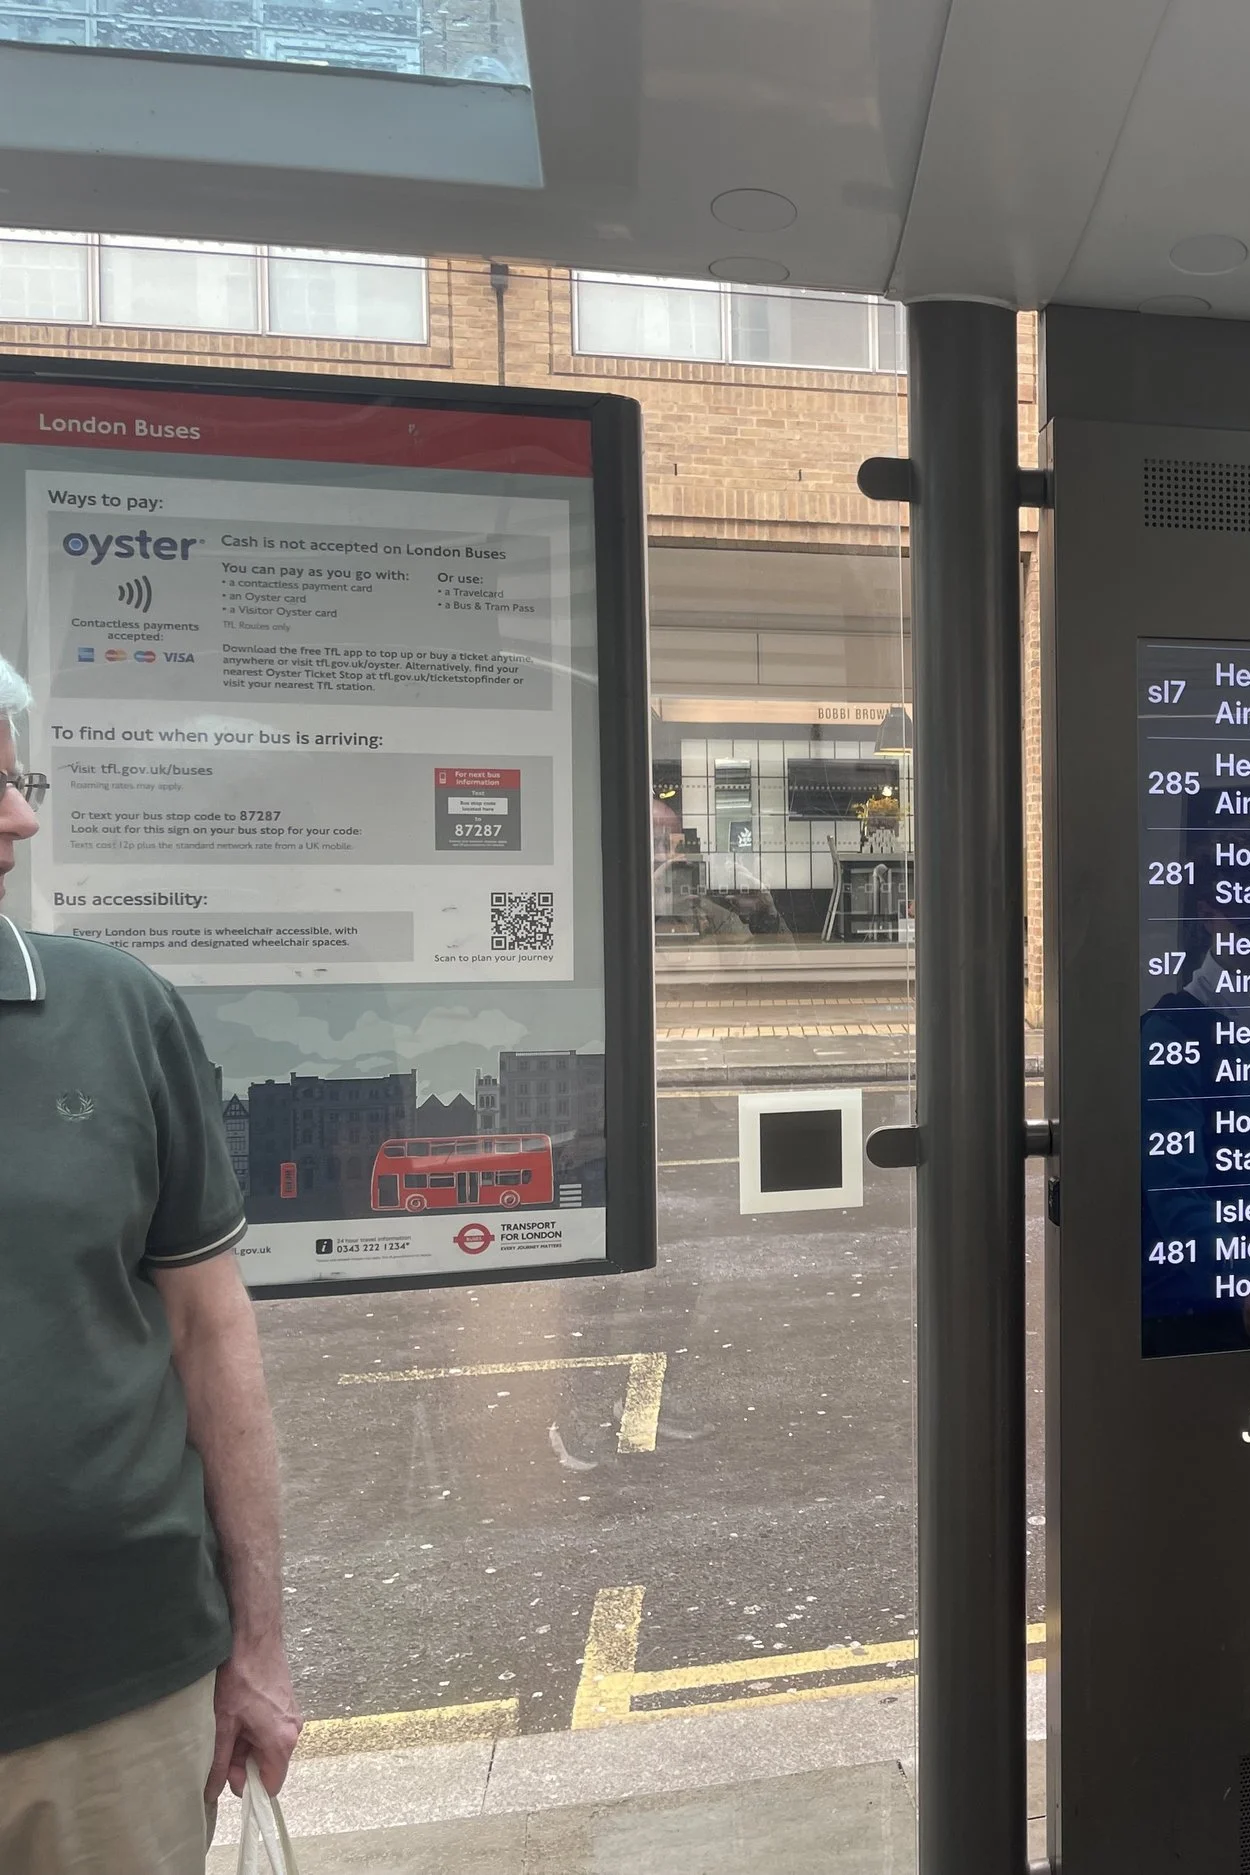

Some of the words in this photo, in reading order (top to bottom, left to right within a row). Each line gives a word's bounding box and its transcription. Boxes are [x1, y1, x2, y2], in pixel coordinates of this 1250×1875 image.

[39, 413, 126, 435] London
[134, 419, 200, 439] Buses
[47, 489, 96, 508] Ways
[101, 493, 121, 507] to
[126, 497, 164, 512] pay:
[62, 529, 197, 565] oyster
[220, 534, 258, 547] Cash
[263, 536, 275, 548] is
[279, 539, 305, 550] not
[310, 541, 378, 554] accepted
[383, 545, 401, 554] on
[406, 543, 460, 557] London
[465, 546, 506, 559] Buses
[221, 562, 246, 573] You
[251, 565, 275, 574] can
[279, 567, 303, 578] pay
[308, 568, 322, 577] as
[326, 569, 351, 579] you
[355, 570, 371, 581] go
[375, 569, 409, 580] with:
[71, 617, 140, 629] Contactless
[143, 622, 199, 634] payments
[107, 630, 164, 642] accepted:
[163, 652, 194, 663] VISA
[222, 656, 274, 669] anywhere
[291, 658, 313, 666] visit
[474, 663, 494, 672] find
[496, 666, 518, 676] your
[222, 667, 263, 676] nearest
[265, 668, 301, 679] Oyster
[304, 667, 336, 678] Ticket
[339, 670, 363, 684] Stop
[365, 669, 376, 680] at
[378, 671, 510, 684] tfl.gov.uk/ticketstopfinder
[222, 678, 245, 687] visit
[247, 681, 271, 689] your
[274, 678, 314, 689] nearest
[316, 681, 333, 690] TfL
[335, 680, 374, 691] station.
[818, 707, 850, 719] BOBBI
[51, 725, 73, 739] To
[79, 726, 115, 740] find
[121, 728, 153, 741] out
[158, 728, 208, 742] when
[213, 732, 253, 746] your
[259, 730, 290, 744] bus
[296, 731, 309, 744] is
[314, 732, 383, 749] arriving:
[70, 762, 95, 773] Visit
[100, 763, 213, 776] tfl.gov.uk/buses
[454, 770, 467, 779] For
[1149, 772, 1199, 794] 285
[70, 810, 85, 819] Or
[88, 811, 112, 819] text
[114, 813, 139, 822] your
[142, 811, 163, 820] bus
[165, 812, 191, 822] stop
[193, 812, 221, 821] code
[223, 813, 236, 821] to
[239, 810, 280, 821] 87287
[71, 824, 98, 833] Look
[101, 825, 121, 833] out
[124, 824, 140, 833] for
[143, 825, 164, 833] this
[167, 825, 189, 836] sign
[210, 827, 234, 836] your
[237, 825, 257, 834] bus
[260, 826, 284, 836] stop
[287, 825, 303, 834] for
[306, 827, 330, 836] your
[332, 826, 362, 835] code:
[454, 824, 501, 836] 87287
[1149, 862, 1193, 884] 281
[54, 892, 86, 905] Bus
[92, 892, 208, 908] accessibility:
[72, 928, 102, 939] Every
[104, 927, 146, 936] London
[149, 927, 168, 936] bus
[203, 927, 212, 935] is
[214, 927, 273, 935] wheelchair
[334, 926, 357, 934] with
[131, 940, 165, 949] ramps
[167, 939, 187, 947] and
[190, 938, 249, 949] designated
[251, 937, 309, 946] wheelchair
[312, 939, 349, 947] spaces.
[434, 954, 456, 962] Scan
[471, 954, 492, 962] plan
[517, 954, 553, 962] journey
[1149, 1042, 1200, 1065] 285
[1150, 1131, 1194, 1155] 281
[500, 1221, 556, 1231] TRANSPORT
[500, 1232, 519, 1241] FOR
[521, 1230, 562, 1240] LONDON
[336, 1244, 359, 1253] 0343
[362, 1243, 379, 1251] 222
[1149, 1240, 1195, 1264] 481
